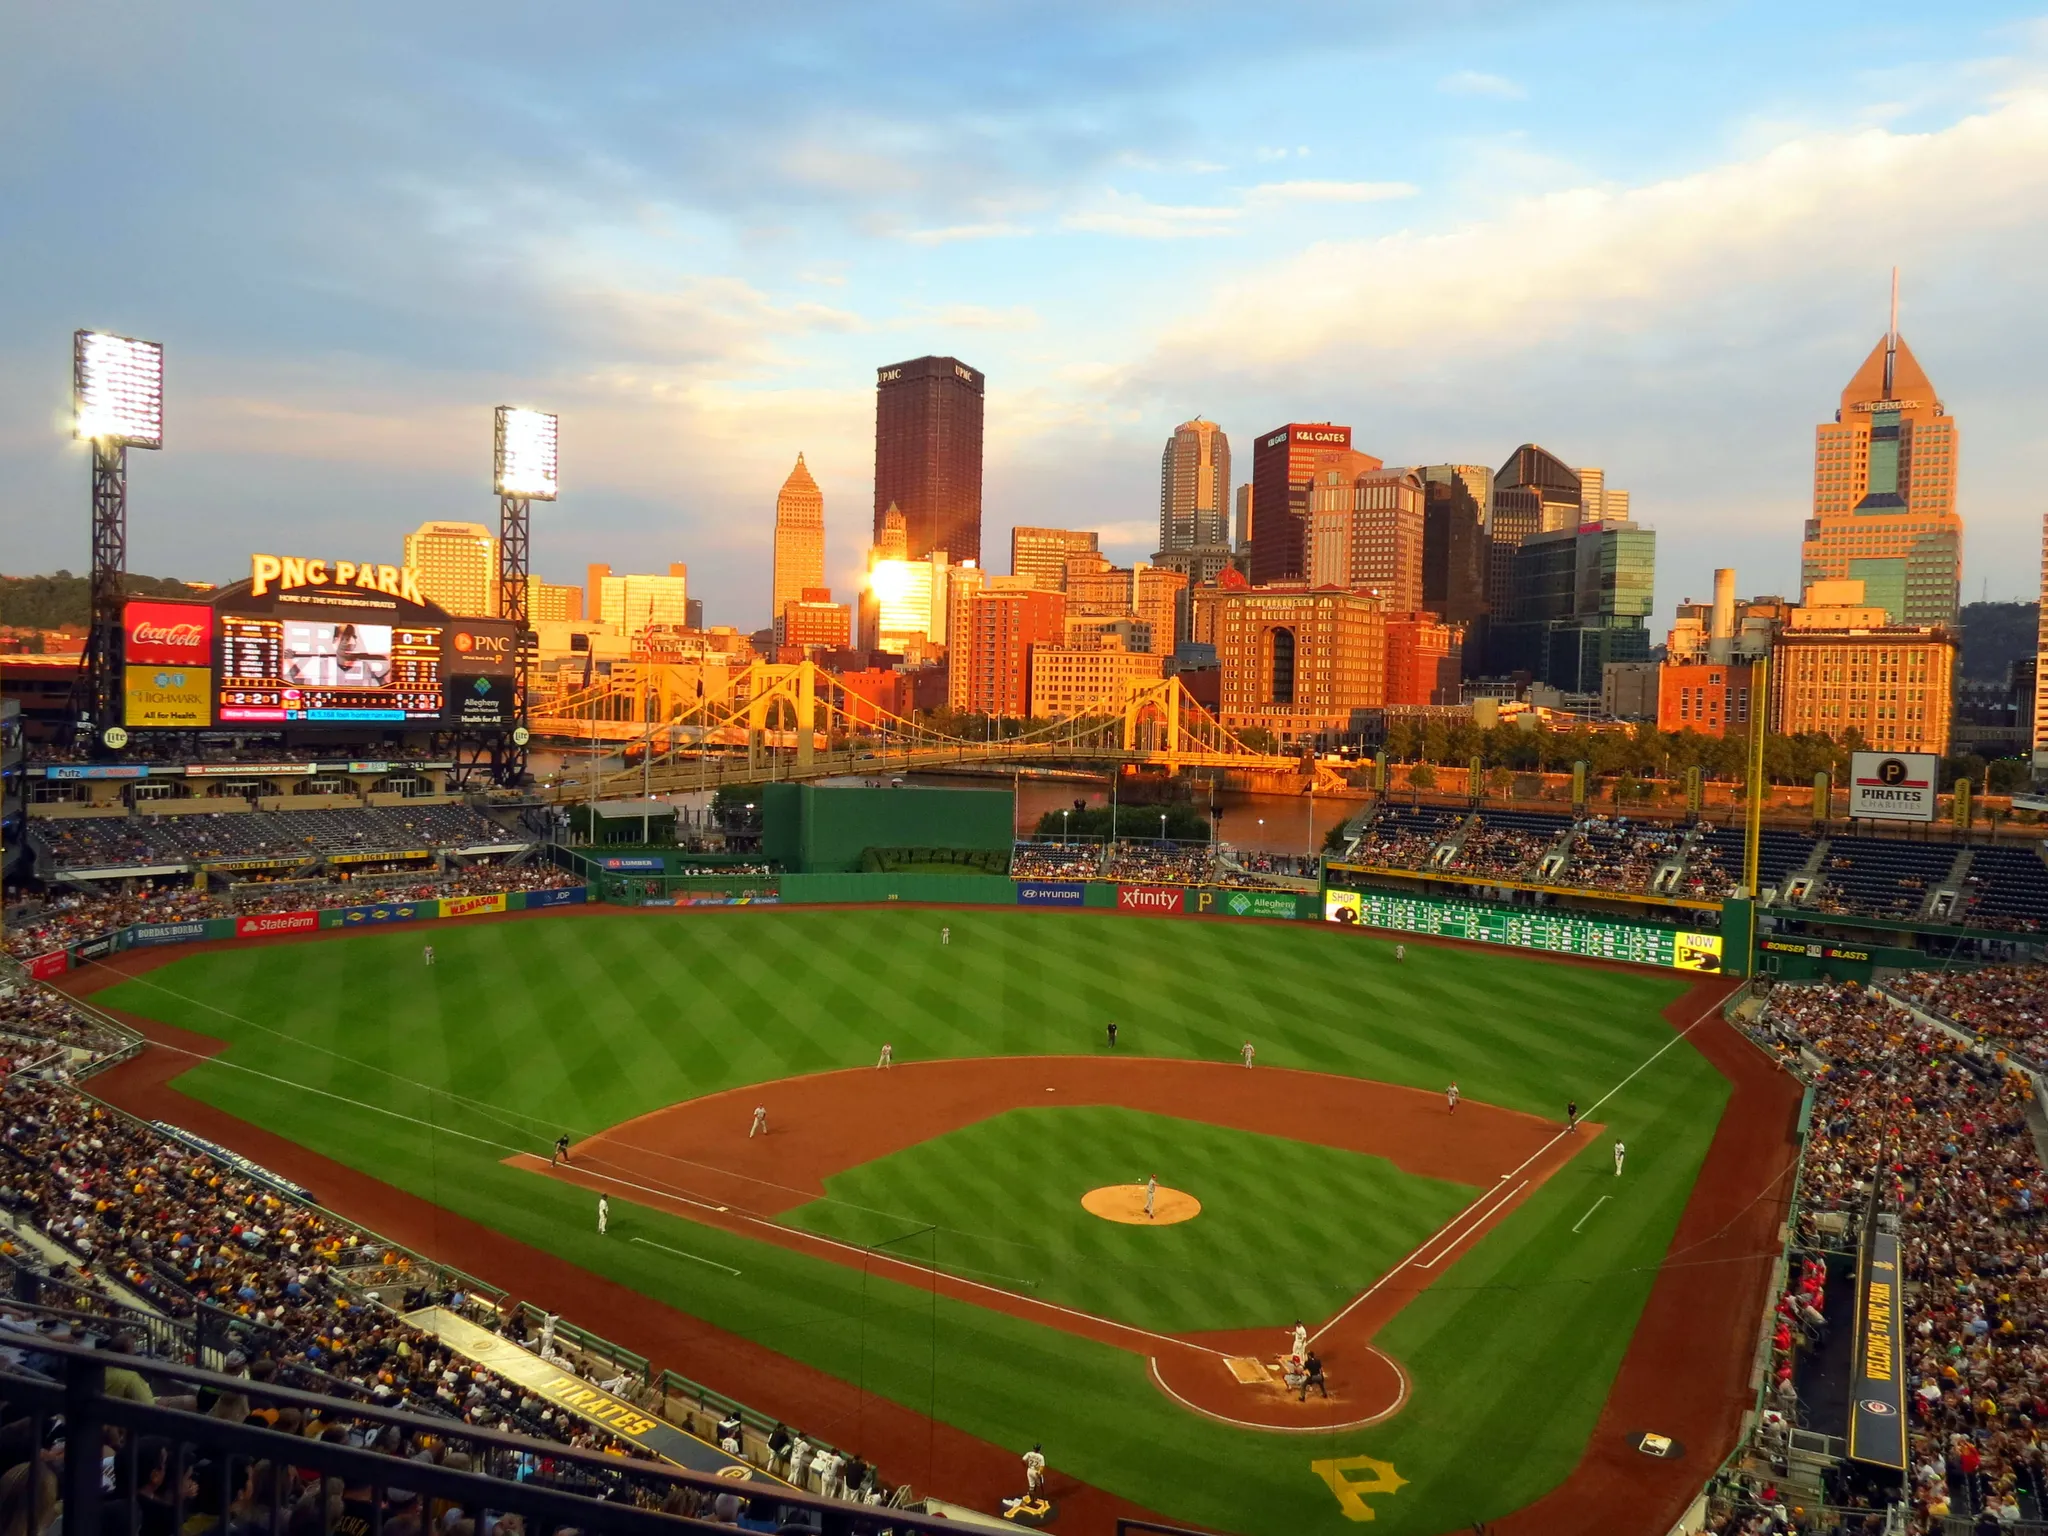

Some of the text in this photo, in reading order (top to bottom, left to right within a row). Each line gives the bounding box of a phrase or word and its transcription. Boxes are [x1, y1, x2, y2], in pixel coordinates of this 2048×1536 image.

[877, 368, 901, 383] UPMC
[955, 364, 972, 382] UPMC
[1296, 431, 1345, 443] K&L GATES
[252, 553, 426, 607] PNC PARK
[279, 594, 300, 602] HOME
[312, 596, 326, 604] THE
[327, 598, 369, 607] PITTSBURGH
[370, 601, 396, 609] PIRATES
[132, 621, 204, 647] Coca-Cola
[402, 633, 412, 644] 0
[425, 634, 432, 645] 1
[475, 636, 510, 652] PNC
[137, 692, 204, 704] HIGHMARK
[235, 693, 246, 704] 2
[252, 693, 262, 704] 2
[270, 694, 278, 704] 1
[464, 698, 499, 708] Allegheny
[108, 732, 126, 743] Lite
[516, 732, 528, 740] Lite
[1886, 765, 1900, 781] P
[1862, 788, 1922, 802] PIRATES
[1860, 800, 1921, 810] CHARITIES
[274, 859, 299, 867] BEER
[556, 892, 570, 900] JDP
[1122, 889, 1178, 910] xfinity
[1199, 893, 1212, 912] P
[1332, 892, 1355, 903] SHOP
[1254, 899, 1296, 910] Allegheny
[1372, 896, 1492, 915] NATIONAL LEAGUE
[138, 924, 203, 938] BORDAS BORDAS
[1521, 914, 1661, 935] AMERICAN LEAGUE
[1686, 935, 1714, 948] NOW
[1680, 948, 1691, 961] P
[1767, 942, 1805, 953] BOWSER
[1831, 950, 1868, 960] BLASTS
[1869, 1281, 1891, 1304] PARK
[1868, 1300, 1891, 1325] PNC
[1866, 1332, 1892, 1380] WELCOME
[542, 1376, 658, 1436] PIRATES
[1311, 1454, 1411, 1522] P
